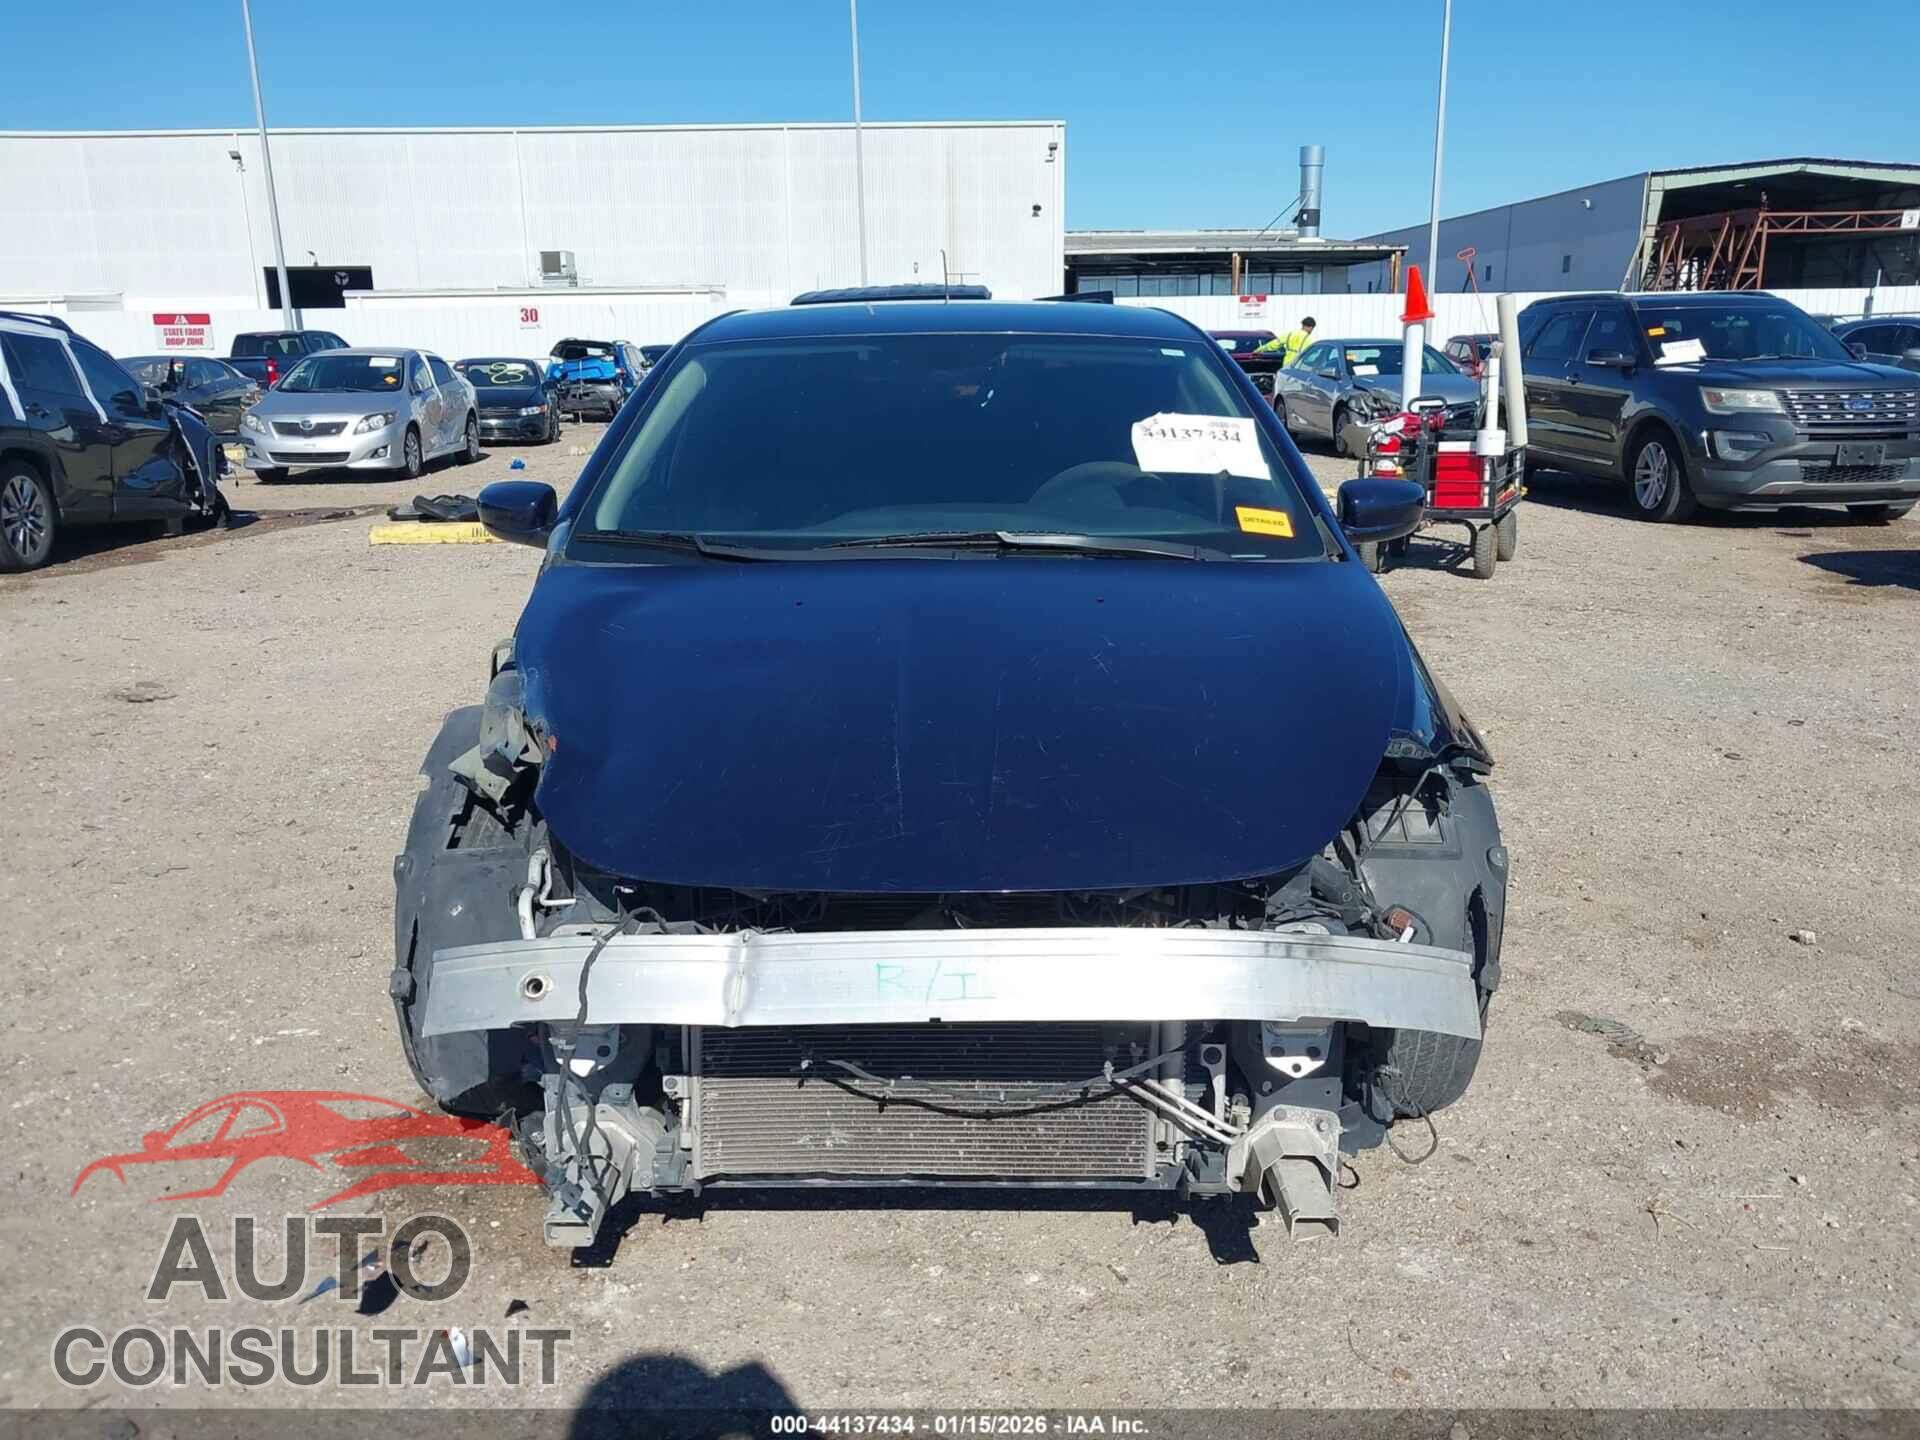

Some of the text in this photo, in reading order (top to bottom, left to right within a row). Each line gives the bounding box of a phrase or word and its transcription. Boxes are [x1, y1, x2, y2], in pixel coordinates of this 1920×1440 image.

[520, 307, 538, 322] 30
[163, 327, 183, 337] STATE
[165, 337, 204, 346] DROP ZONE
